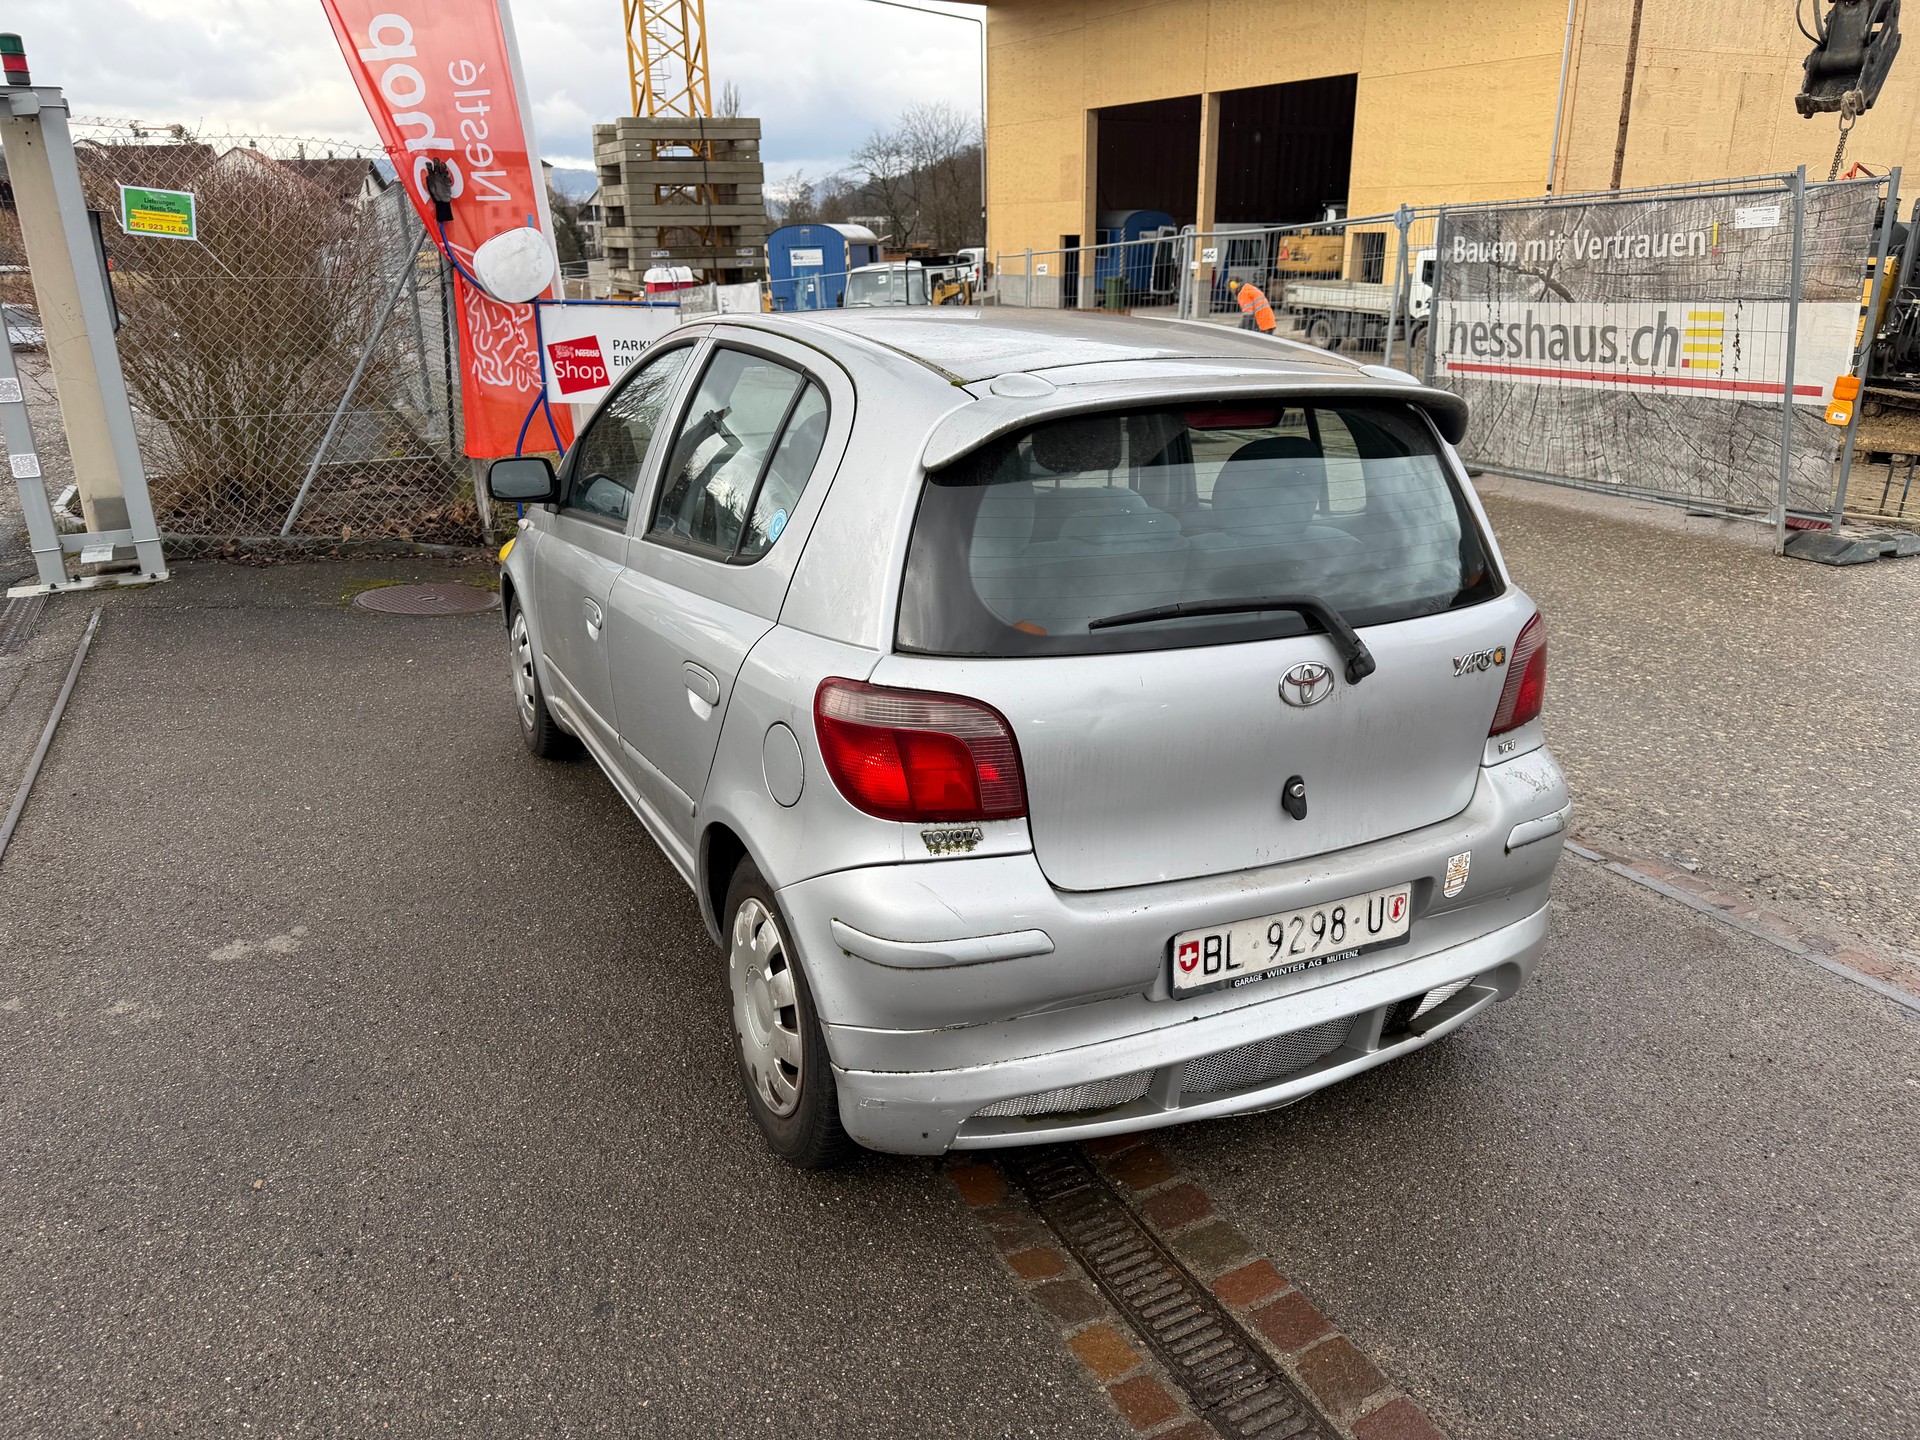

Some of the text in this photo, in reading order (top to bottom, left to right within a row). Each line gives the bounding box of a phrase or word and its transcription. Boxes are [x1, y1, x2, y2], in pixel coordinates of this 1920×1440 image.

[130, 221, 146, 229] 061
[148, 223, 164, 231] 923
[1453, 235, 1517, 264] Bauen
[1524, 230, 1565, 262] mit
[1449, 307, 1680, 368] hesshaus.ch
[554, 360, 605, 384] Shop
[921, 828, 983, 845] TOYOTA
[1203, 896, 1385, 976] BL 9298 U
[1234, 949, 1359, 988] GARAGE WINTER AG MUTTENZ
